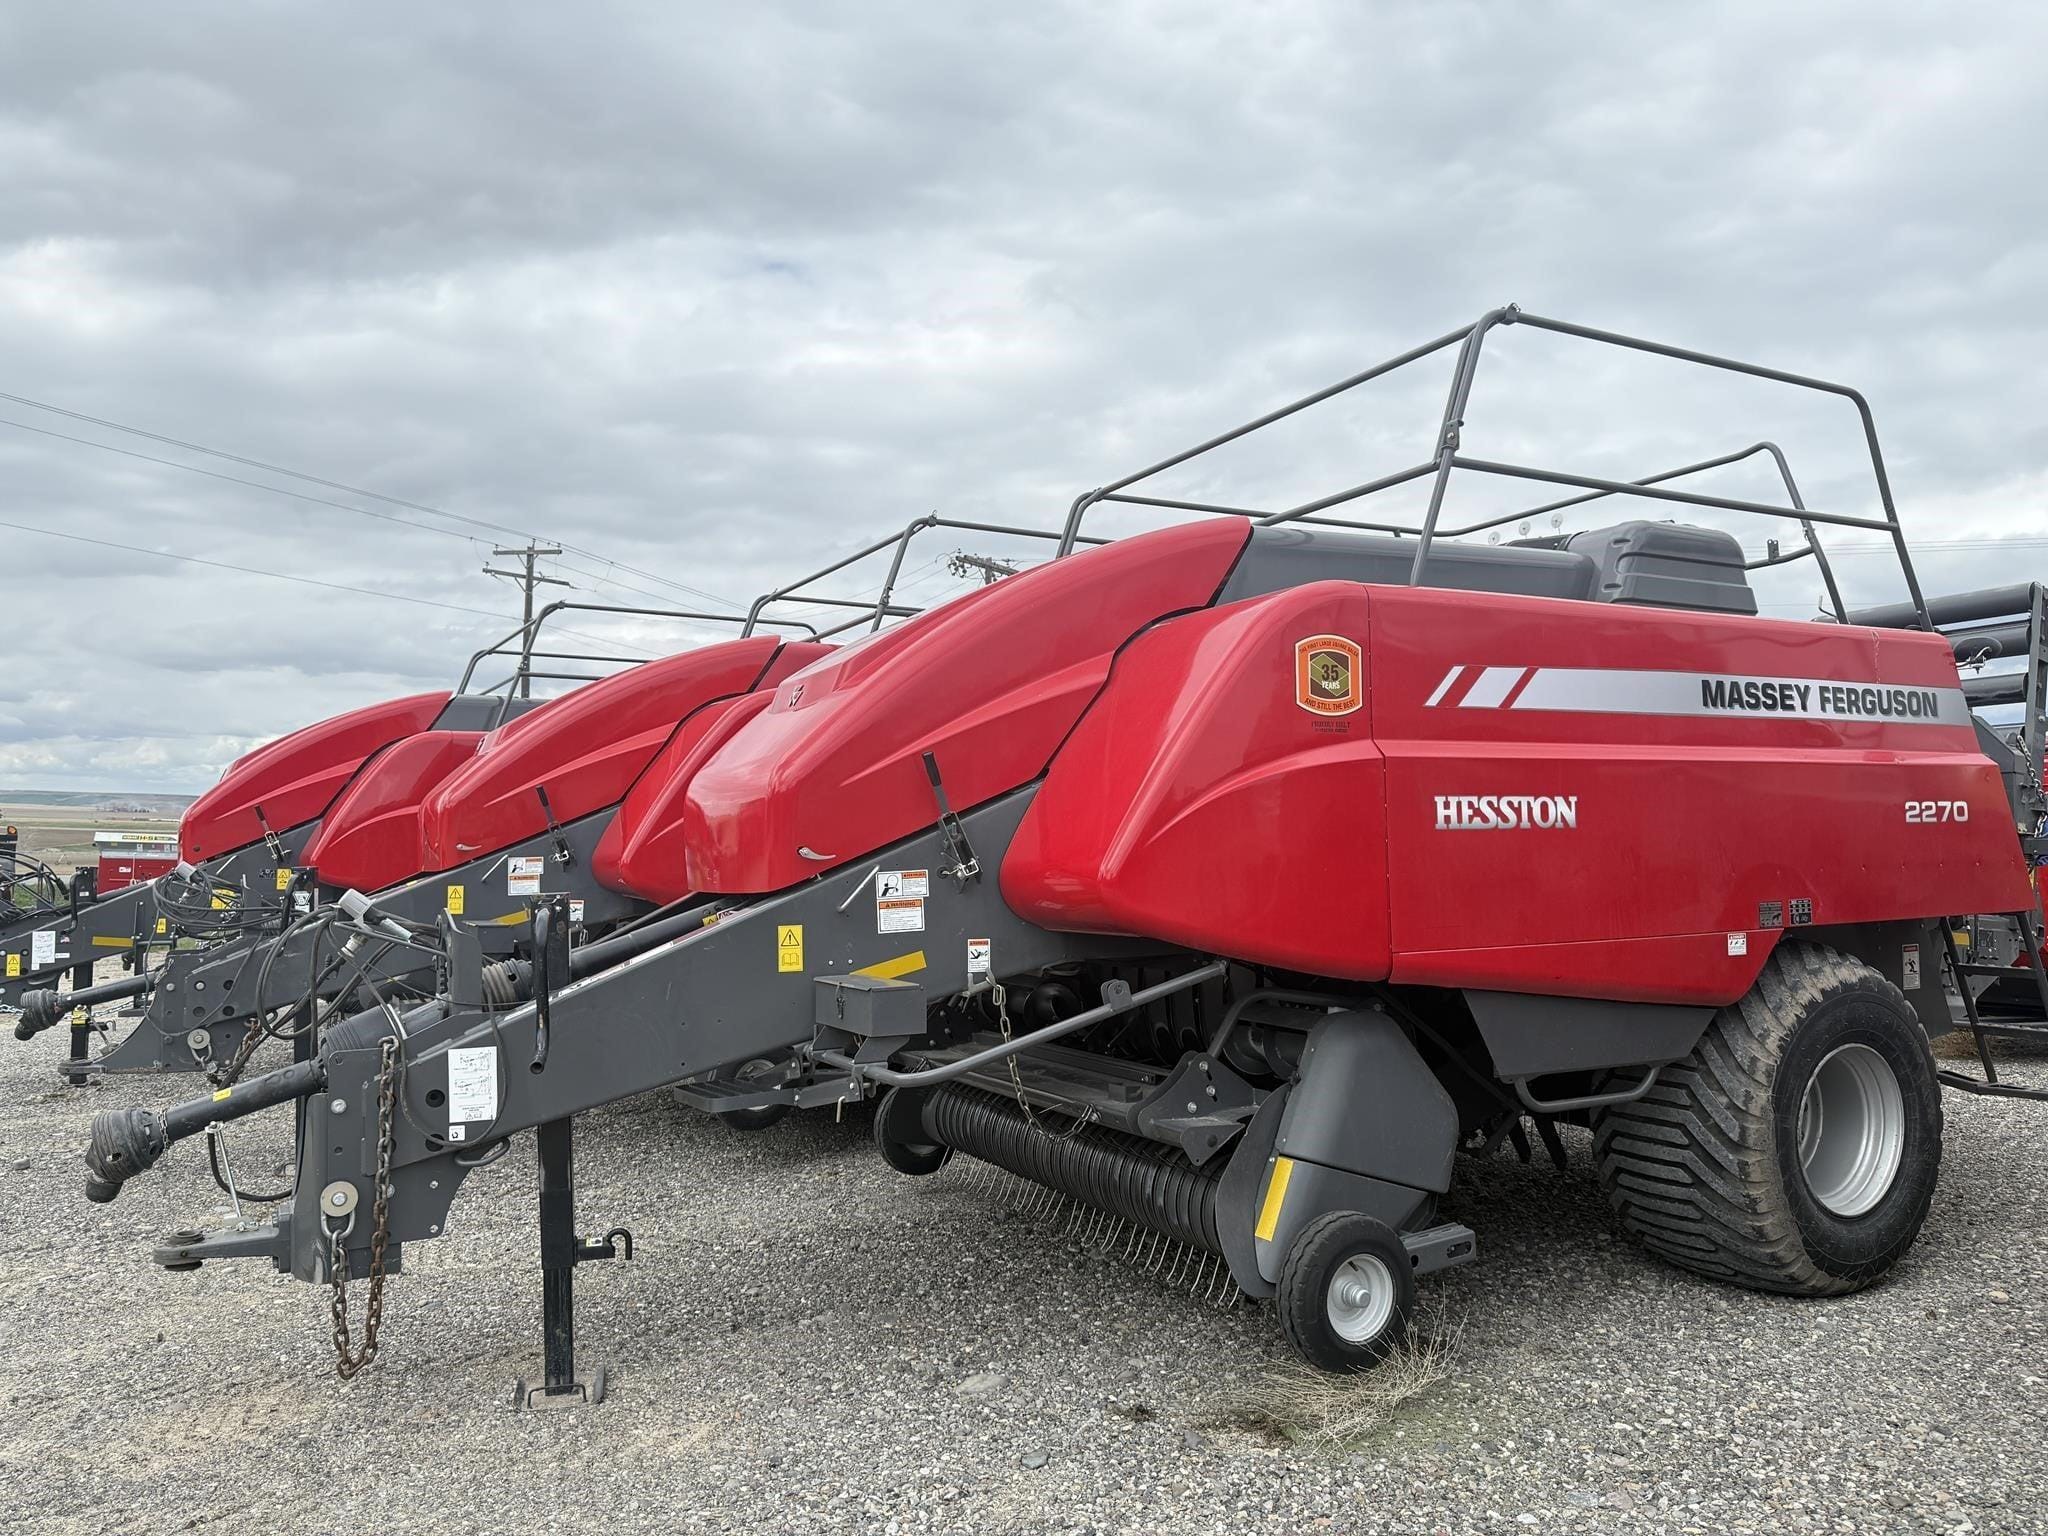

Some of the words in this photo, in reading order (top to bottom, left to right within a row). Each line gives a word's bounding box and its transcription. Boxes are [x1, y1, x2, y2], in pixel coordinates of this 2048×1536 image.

[1321, 664, 1339, 682] 35
[1321, 680, 1341, 690] YEARS
[1304, 697, 1316, 707] AND
[1317, 702, 1332, 710] STILL
[1343, 699, 1356, 709] BEST
[1700, 679, 1810, 713] MASSEY
[1818, 686, 1938, 718] FERGUSON
[1434, 795, 1578, 830] HESSTON
[1904, 800, 1969, 823] 2270
